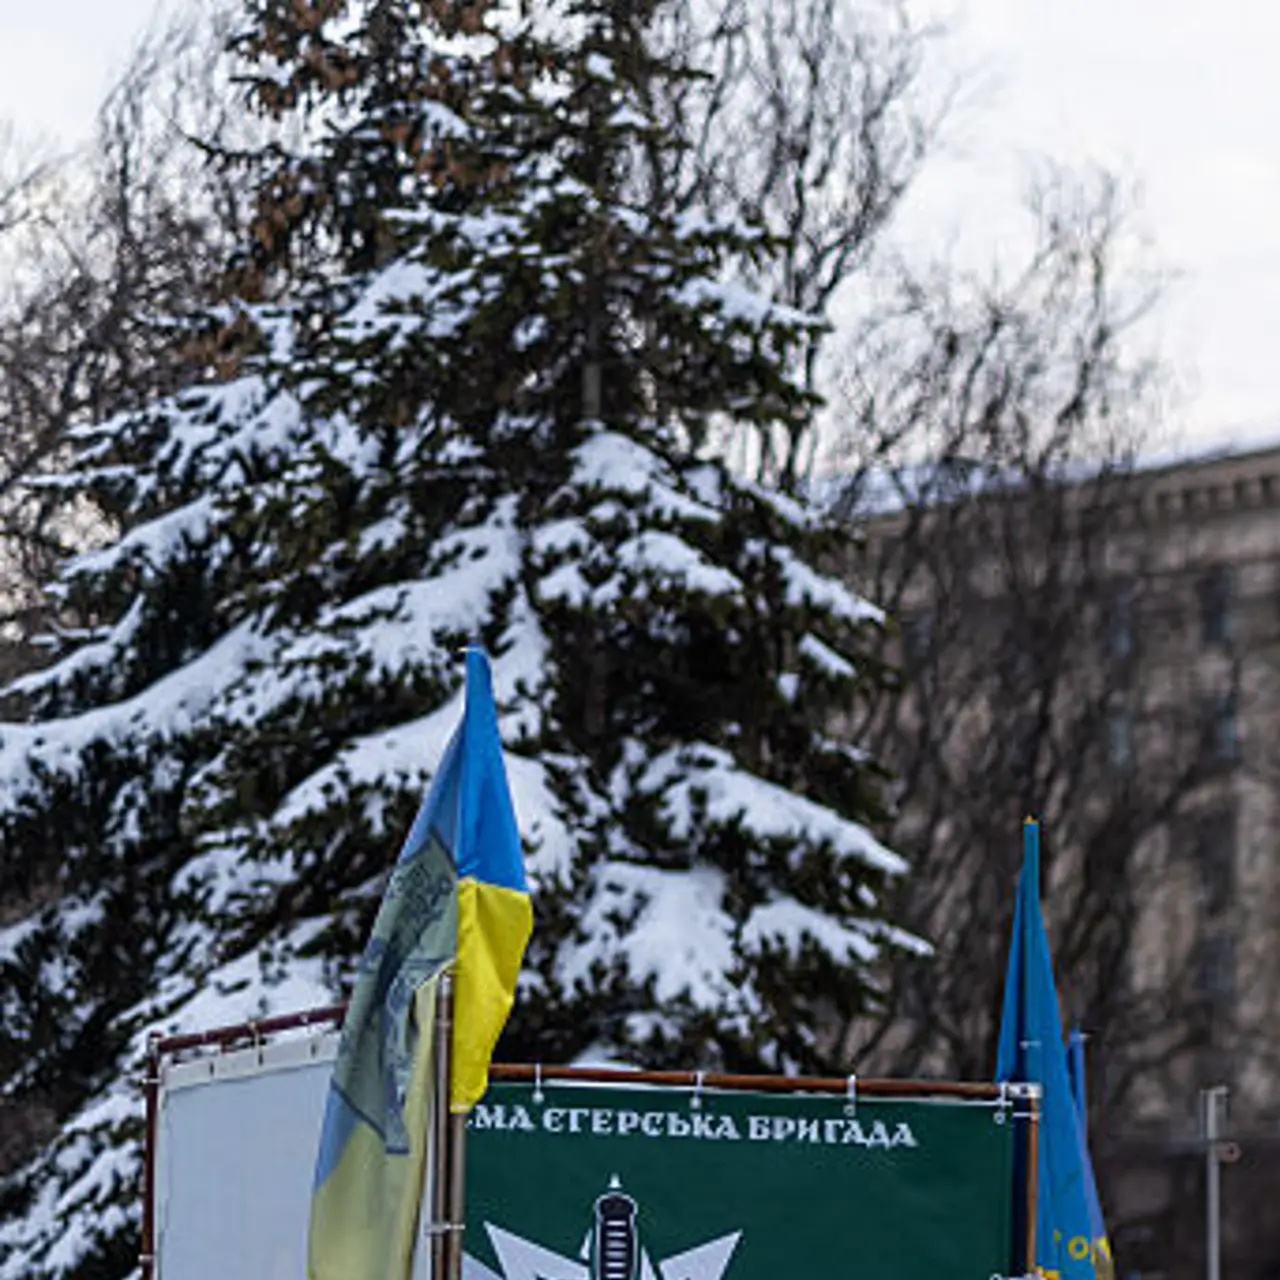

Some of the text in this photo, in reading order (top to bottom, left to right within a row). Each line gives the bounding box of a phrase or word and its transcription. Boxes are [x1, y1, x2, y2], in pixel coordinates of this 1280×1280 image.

[466, 1102, 919, 1149] МА ЄГЕРСЬКА БРИГАДА
